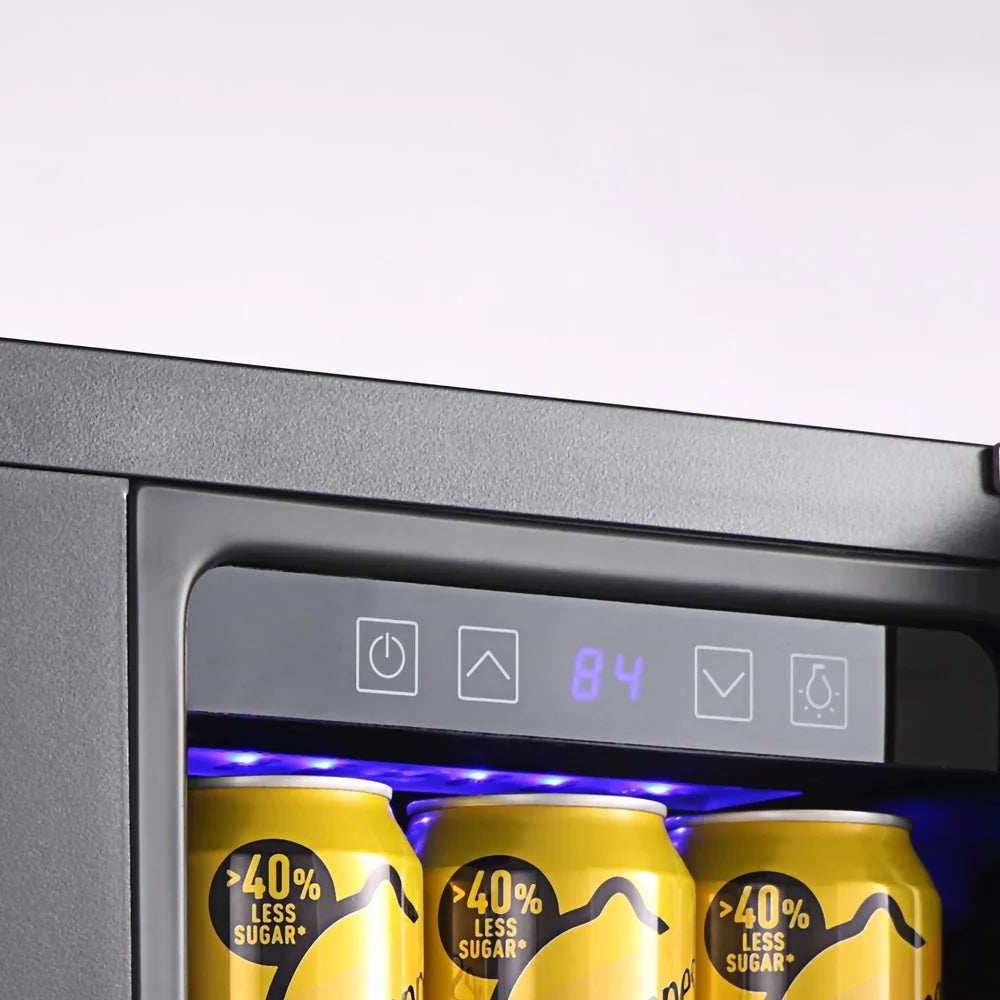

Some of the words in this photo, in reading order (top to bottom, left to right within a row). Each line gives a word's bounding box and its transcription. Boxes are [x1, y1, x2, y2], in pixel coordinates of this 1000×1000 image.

[571, 646, 643, 702] 84
[226, 853, 321, 900] >40%
[452, 869, 543, 915] >40%
[251, 903, 296, 924] LESS
[474, 918, 517, 938] LESS
[719, 884, 810, 930] >40%
[742, 932, 785, 952] LESS
